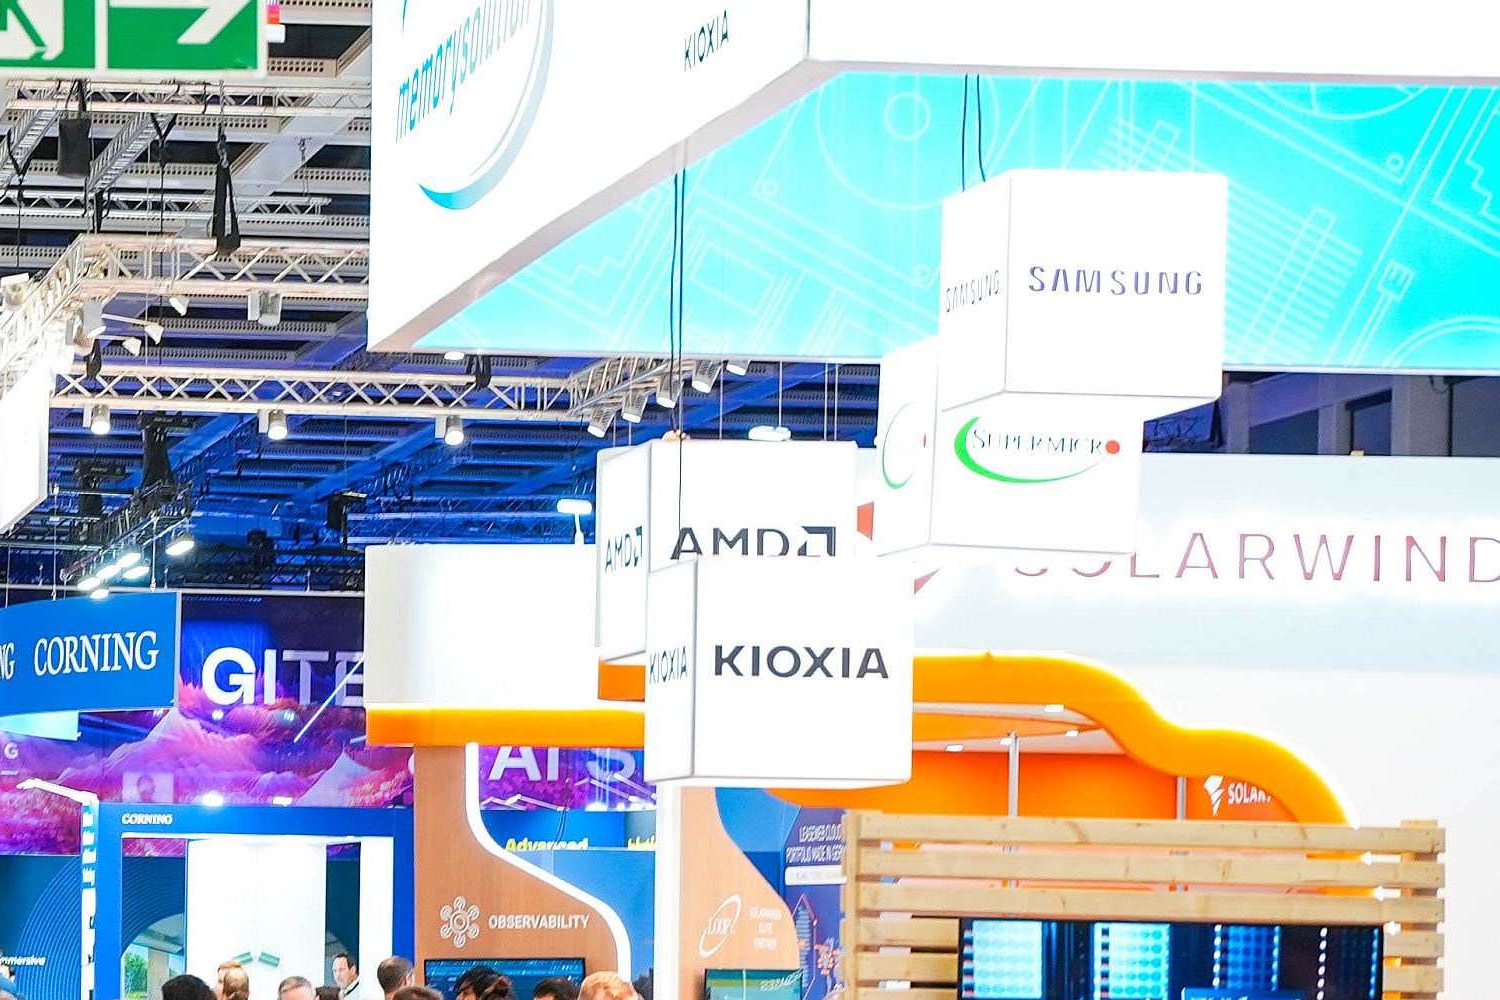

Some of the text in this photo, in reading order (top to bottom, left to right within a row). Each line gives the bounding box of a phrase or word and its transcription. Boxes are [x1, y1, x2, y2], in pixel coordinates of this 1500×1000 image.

[684, 10, 729, 72] KIOXIA
[946, 269, 1000, 313] SAMSUNG
[1028, 266, 1202, 295] SAMSUNG
[604, 532, 632, 574] AMD
[670, 526, 790, 560] AMD
[1014, 532, 1500, 583] LARWIND
[34, 630, 160, 677] CORNING
[649, 645, 688, 684] KIOXIA
[714, 644, 889, 679] KIOXIA
[121, 813, 173, 825] CORNING
[488, 914, 590, 930] OBSERVABILITY
